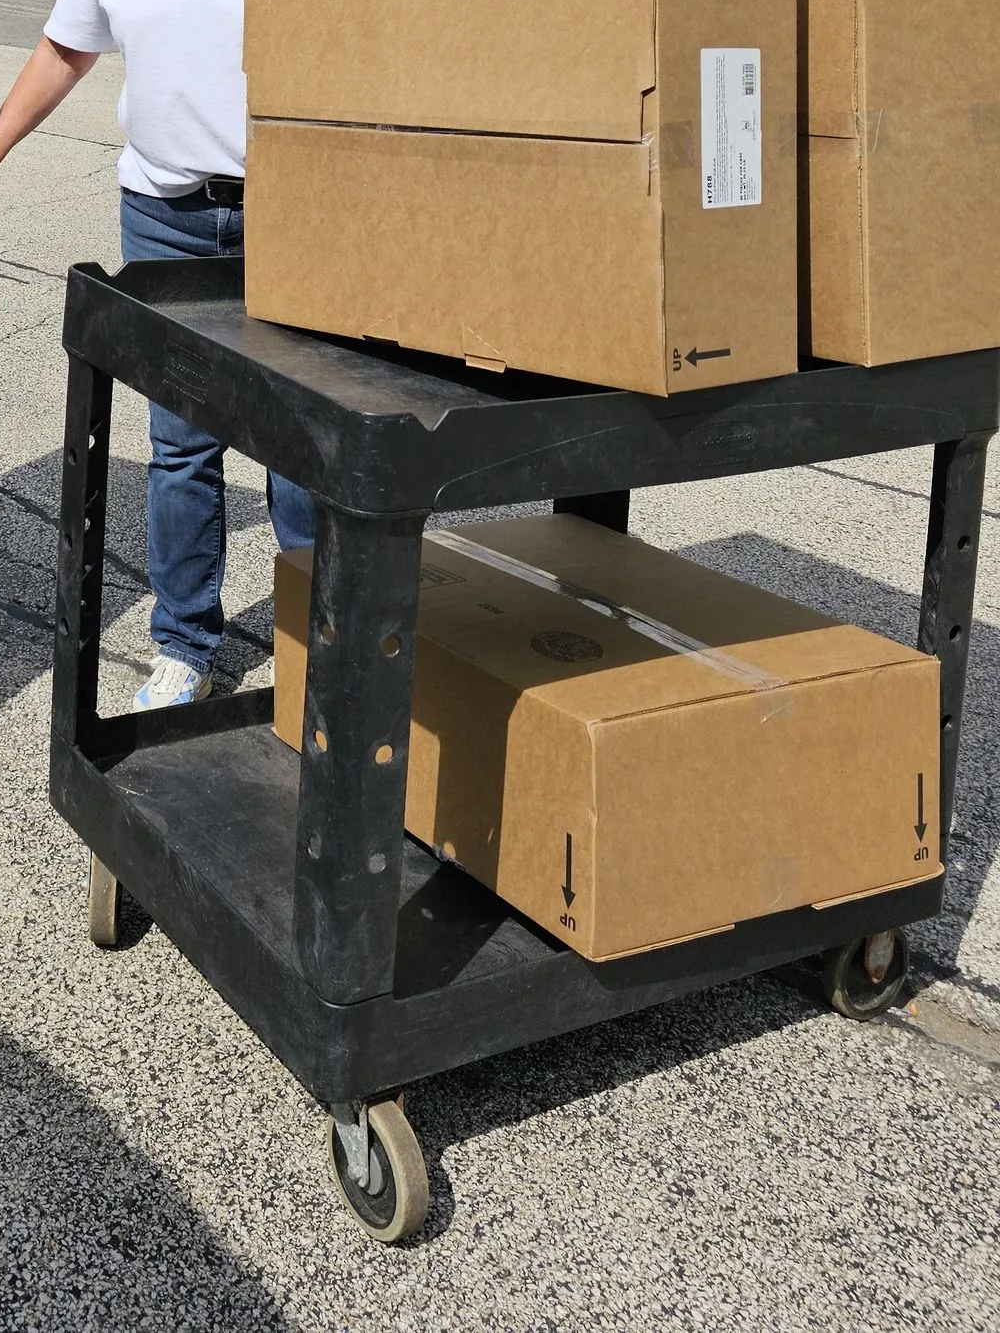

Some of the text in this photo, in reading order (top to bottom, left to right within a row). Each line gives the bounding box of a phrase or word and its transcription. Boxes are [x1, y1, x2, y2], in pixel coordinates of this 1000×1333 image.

[673, 347, 682, 371] UP
[912, 847, 929, 862] UP
[559, 912, 576, 932] UP
